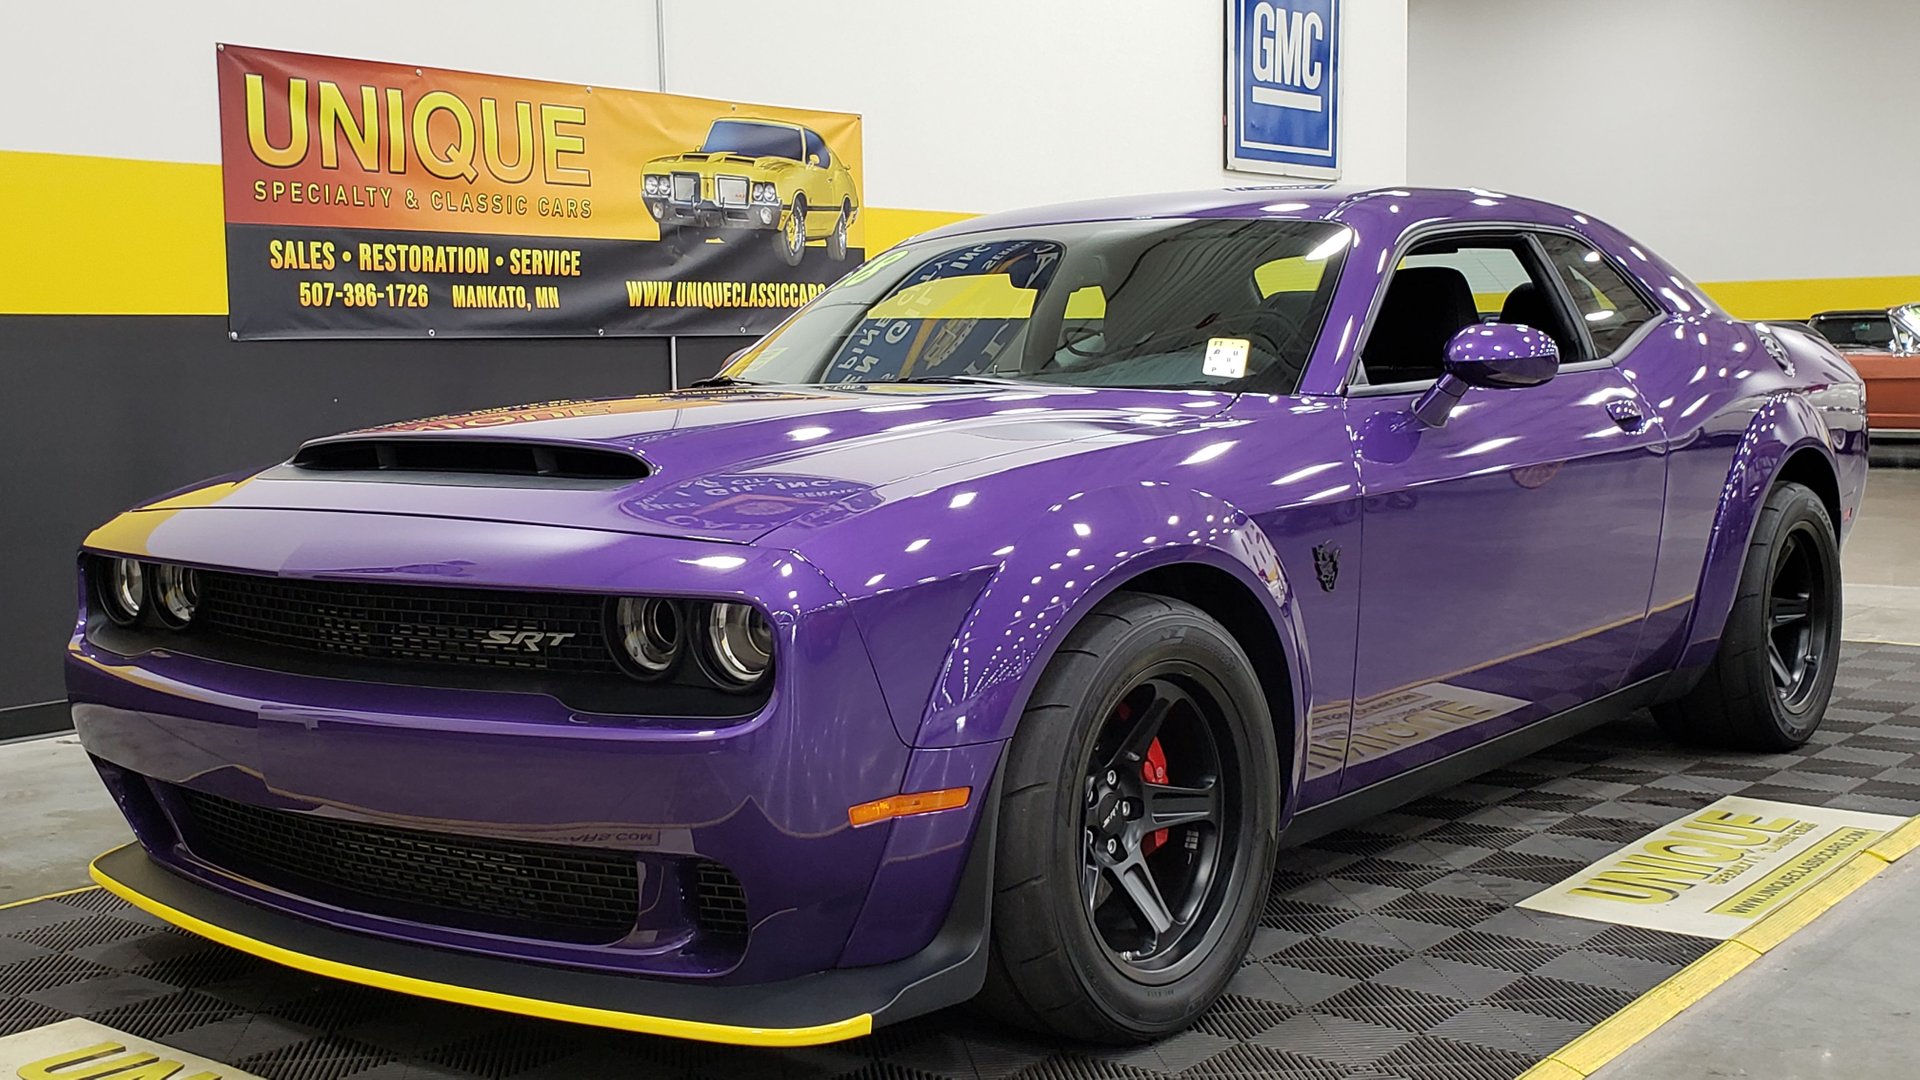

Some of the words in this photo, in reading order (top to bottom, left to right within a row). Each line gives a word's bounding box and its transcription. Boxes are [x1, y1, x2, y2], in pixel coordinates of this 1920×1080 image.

[1252, 1, 1323, 90] GMC
[244, 73, 592, 187] UNIQUE
[254, 180, 392, 208] SPECIALTY
[405, 188, 419, 209] &
[430, 190, 527, 216] CLASSIC
[538, 197, 592, 218] CARS
[269, 239, 336, 271] SALES
[358, 243, 489, 274] RESTORATION
[509, 248, 581, 276] SERVICE
[299, 281, 429, 308] 507-386-1726
[452, 285, 532, 311] MANKATO,
[535, 286, 560, 309] MN
[480, 629, 576, 652] SRT
[1566, 810, 1800, 904] UNIQUE
